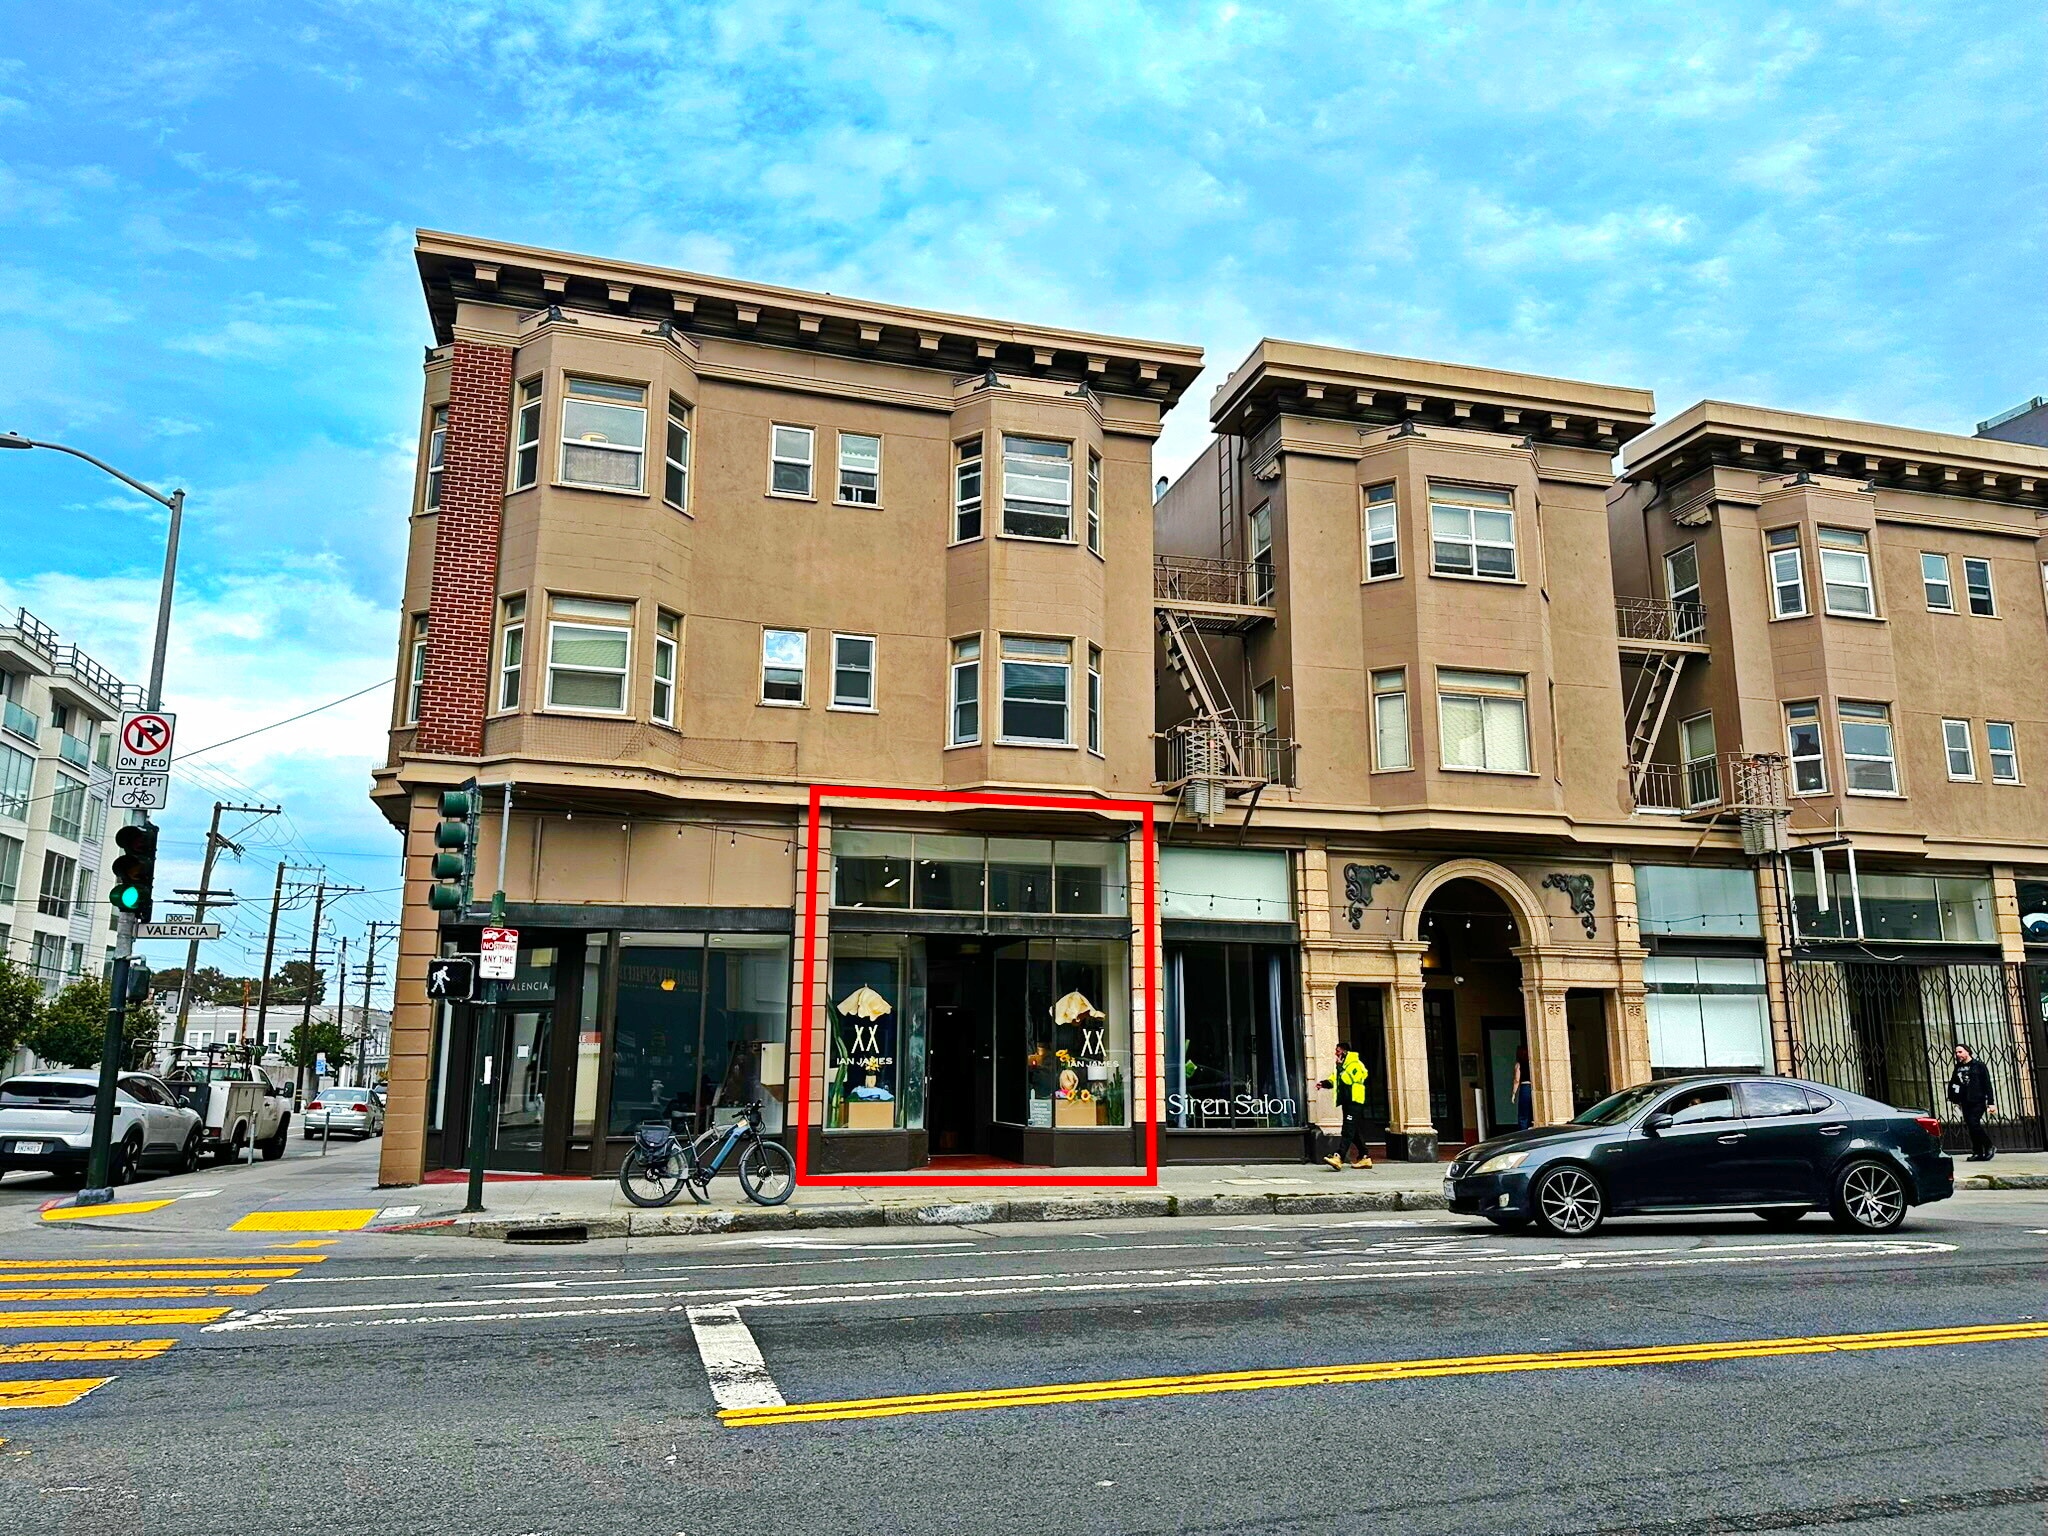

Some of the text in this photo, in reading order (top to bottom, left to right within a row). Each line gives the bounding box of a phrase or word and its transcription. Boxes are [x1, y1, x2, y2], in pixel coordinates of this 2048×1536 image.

[121, 757, 166, 767] ON RED
[119, 776, 163, 787] EXCEPT
[146, 926, 208, 936] VALENCIA
[482, 942, 516, 951] NO STOPPING
[484, 955, 513, 964] ANY TIME
[505, 982, 549, 991] VALENCIA
[836, 1057, 893, 1067] IAN JAMES
[1086, 1060, 1120, 1068] JAMES
[1168, 1093, 1297, 1115] Siren Salon
